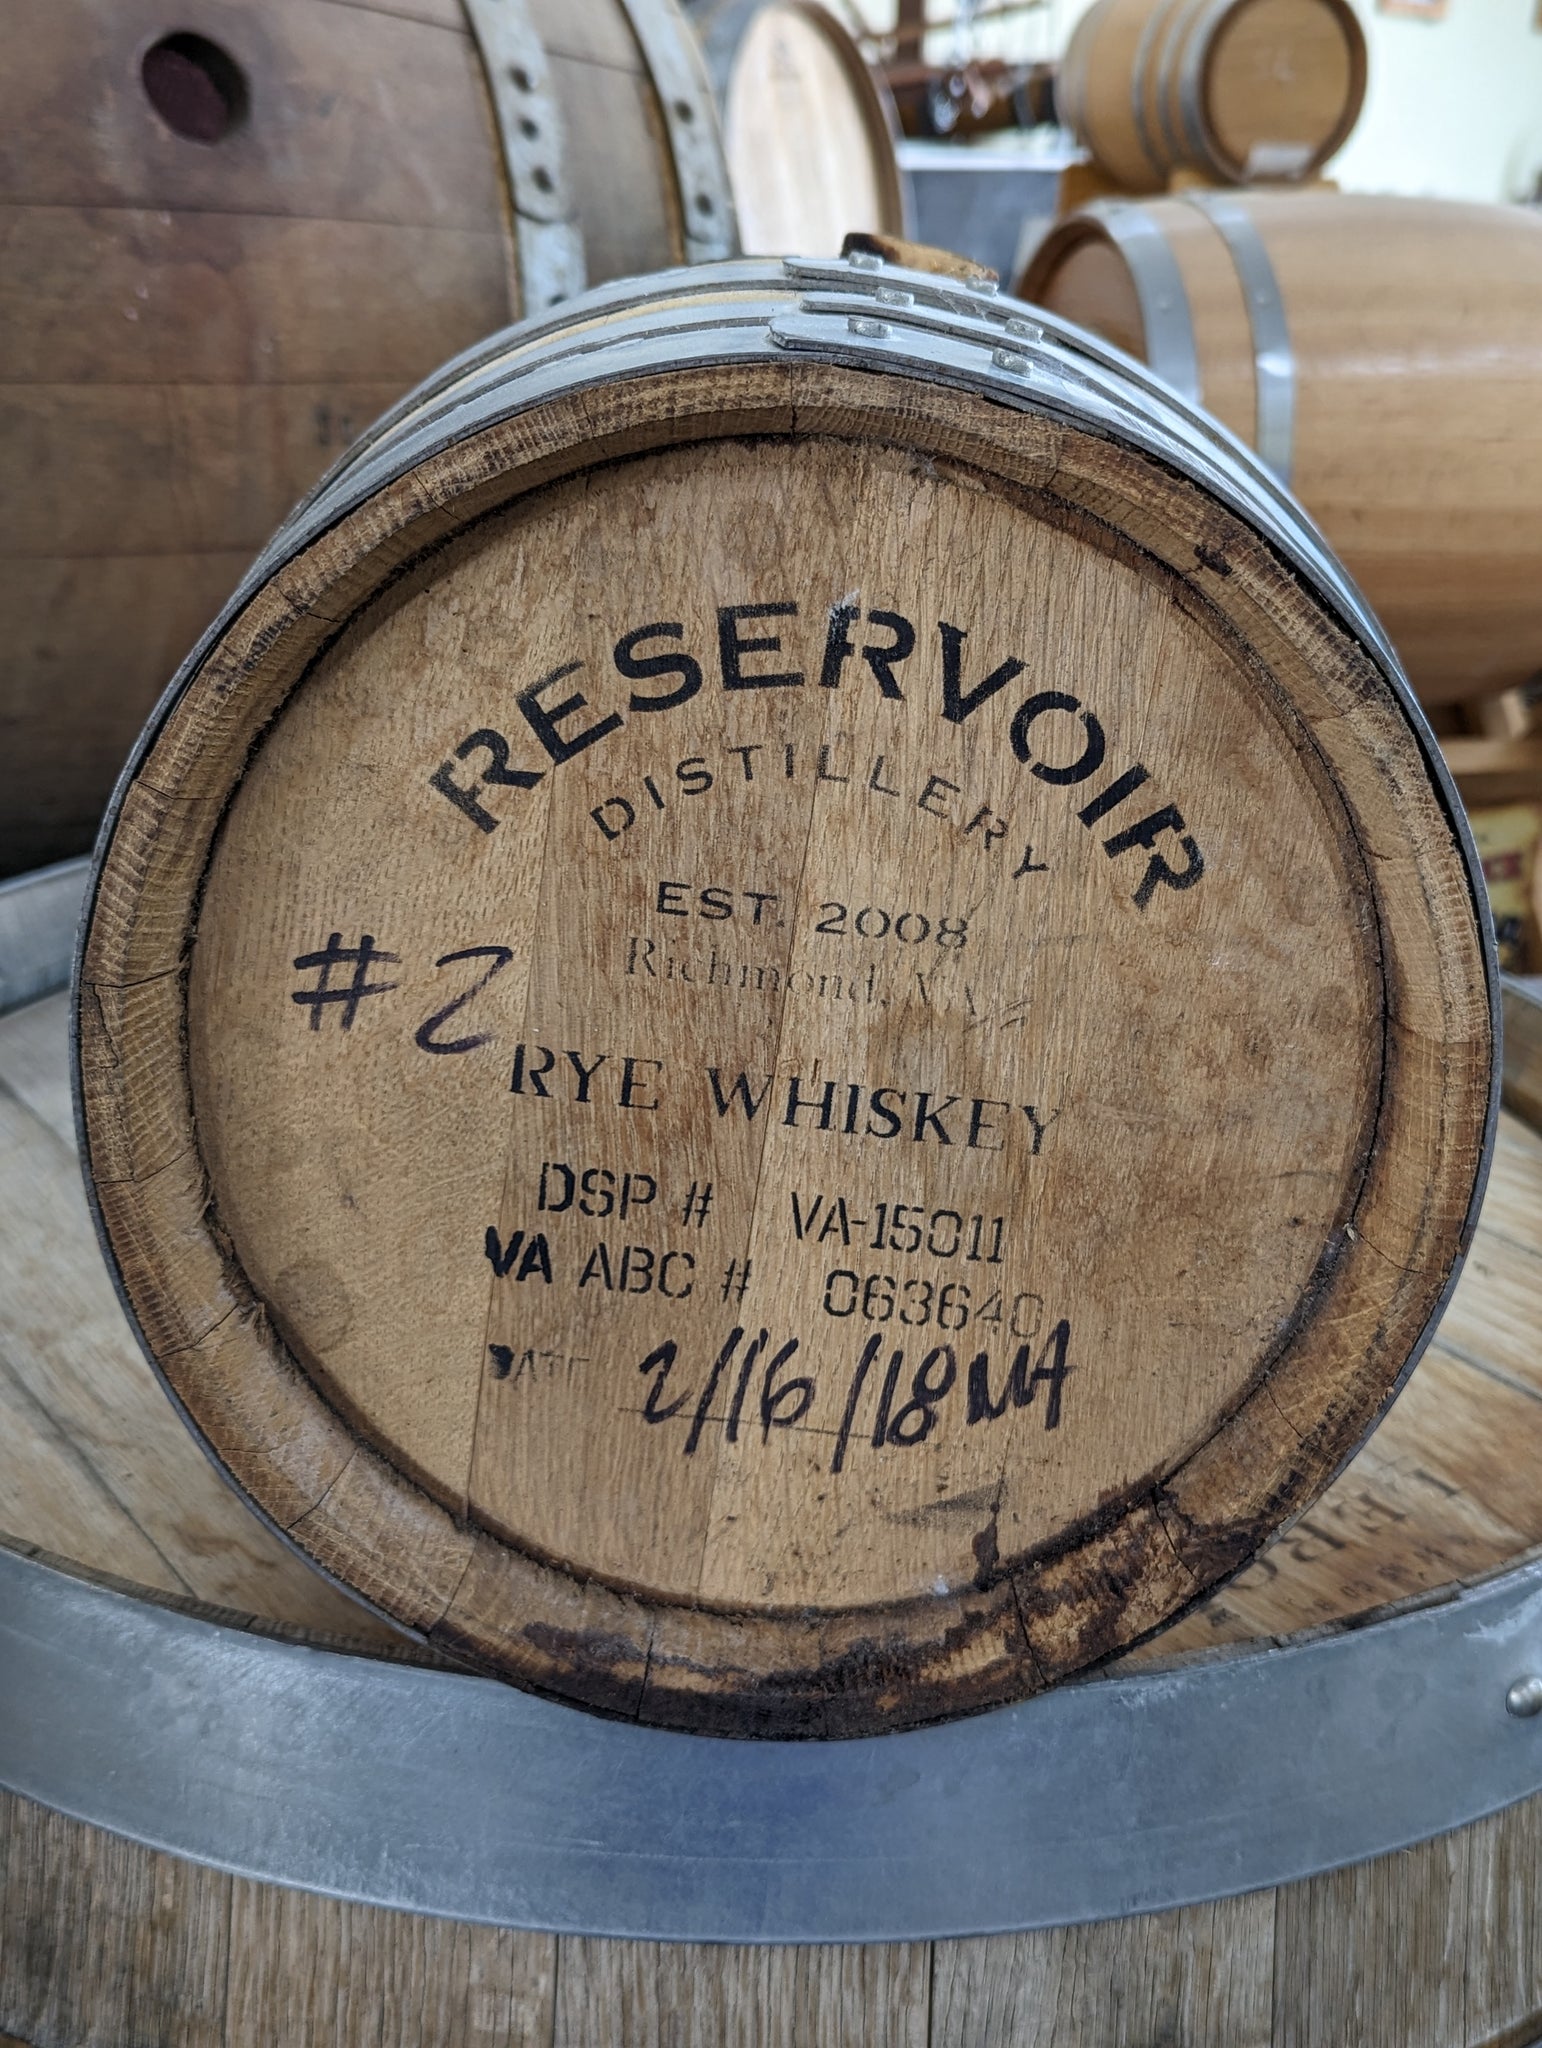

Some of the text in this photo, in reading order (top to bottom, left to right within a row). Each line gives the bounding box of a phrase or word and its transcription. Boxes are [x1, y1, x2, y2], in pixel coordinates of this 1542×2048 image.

[429, 600, 1206, 911] RESERVOIR
[590, 743, 1049, 880] DISTILLERY
[656, 880, 970, 949] EST. 2008
[509, 1043, 1060, 1156] RYE WHISKEY
[538, 1161, 1005, 1264] DSP # VA-15011
[484, 1225, 1045, 1339] VA ABC # 063640
